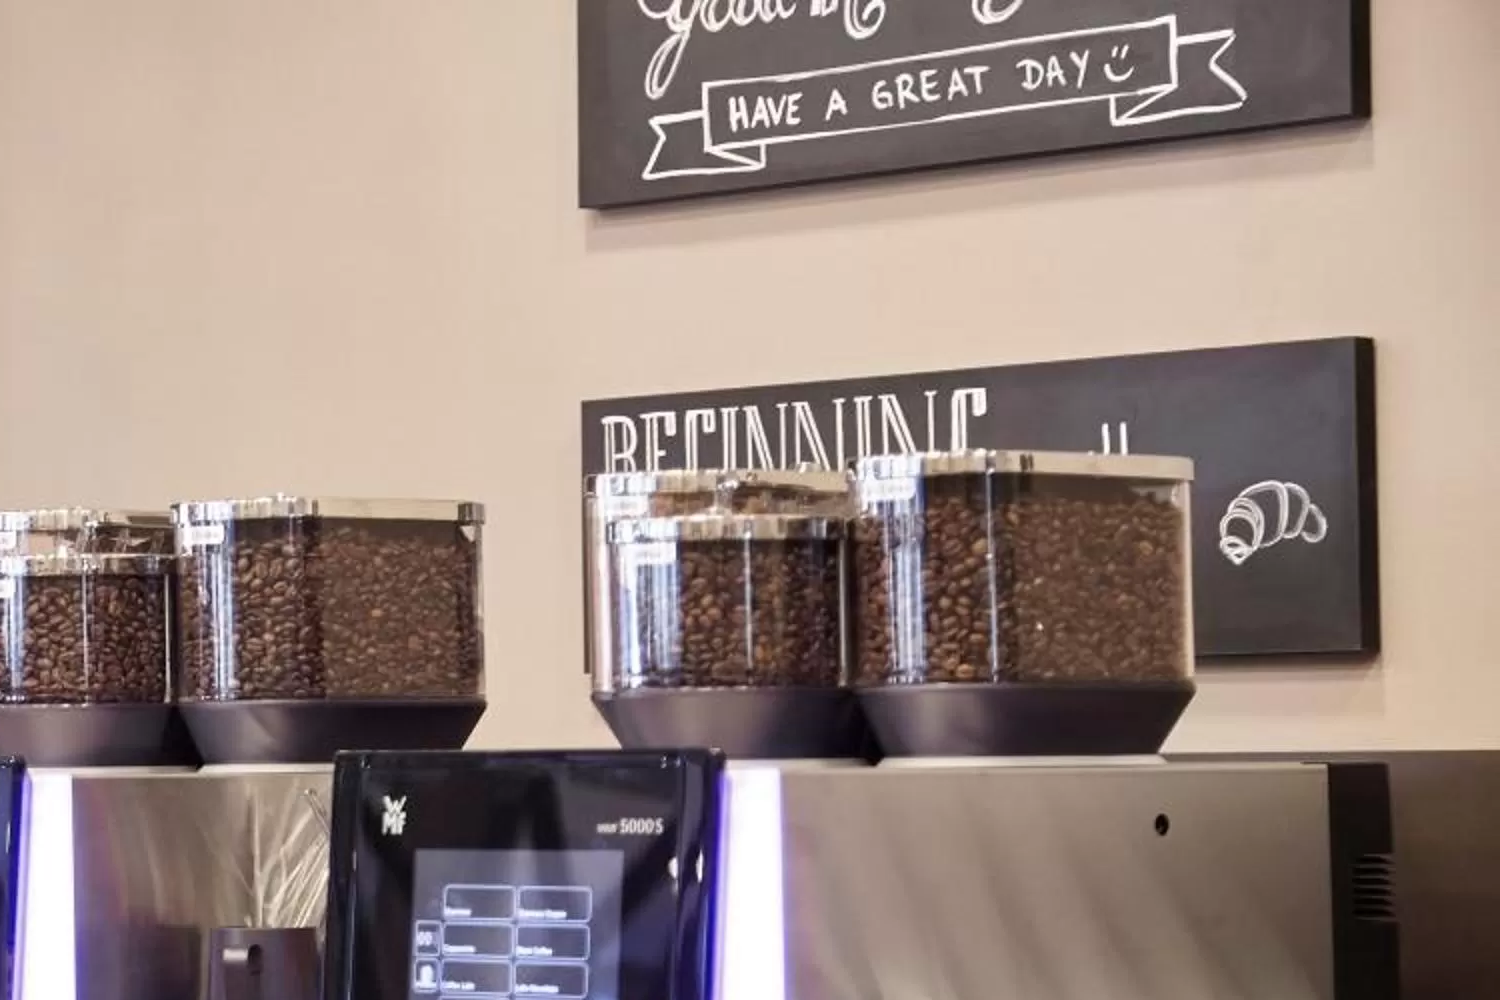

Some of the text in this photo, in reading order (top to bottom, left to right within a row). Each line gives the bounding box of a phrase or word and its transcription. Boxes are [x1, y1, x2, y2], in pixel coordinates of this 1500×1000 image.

[729, 49, 1091, 131] HAVE A GREAT DAY
